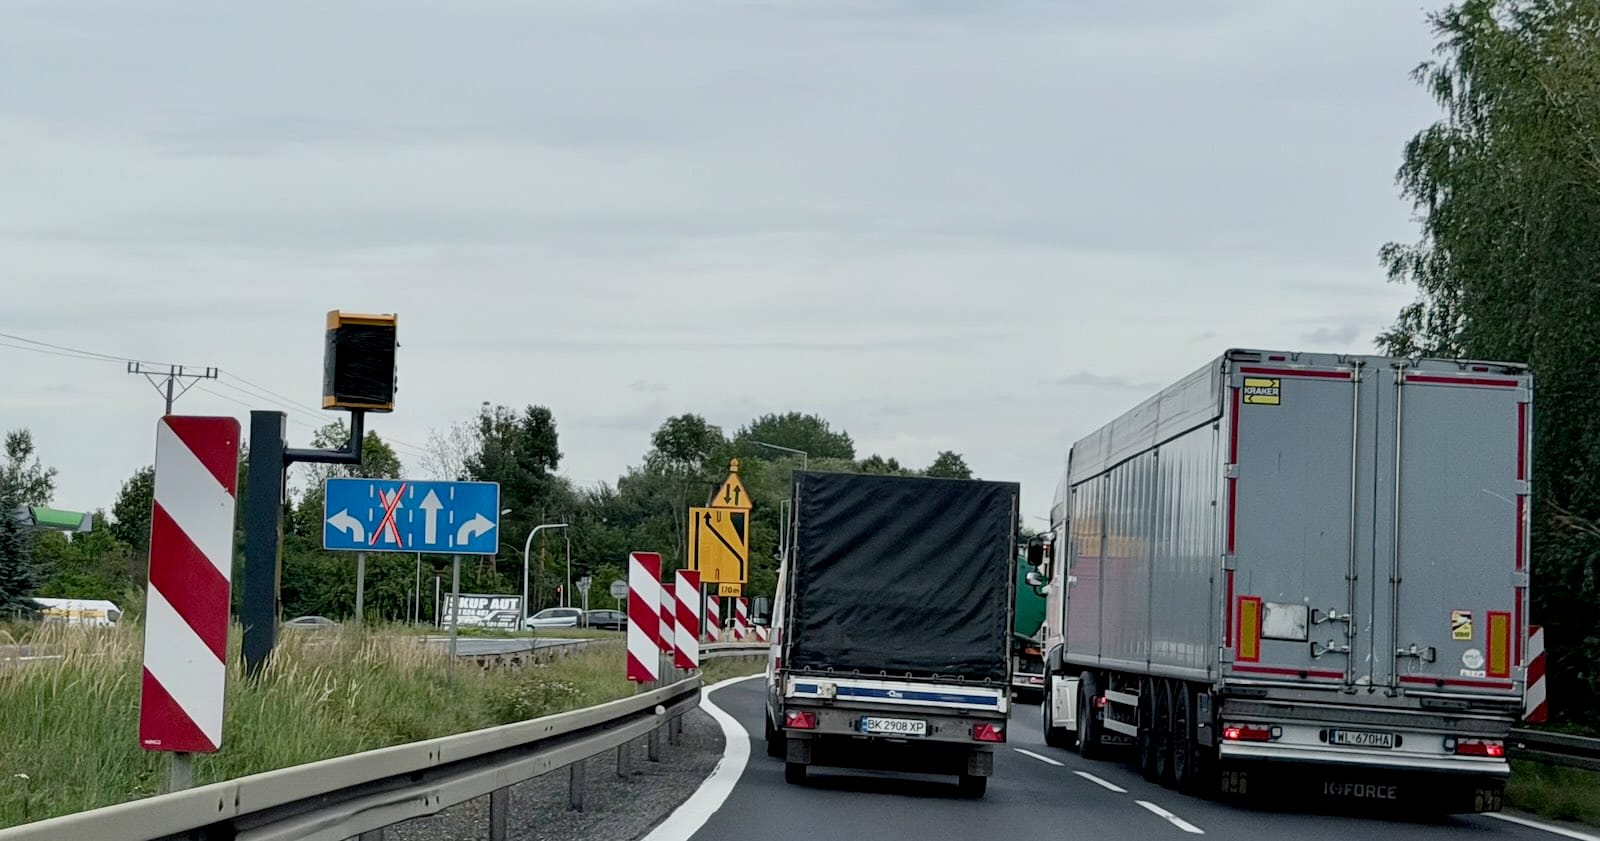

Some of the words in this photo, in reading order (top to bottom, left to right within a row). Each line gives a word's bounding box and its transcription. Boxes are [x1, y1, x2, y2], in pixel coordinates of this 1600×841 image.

[1244, 387, 1279, 396] KRAKER
[490, 597, 518, 609] AUT
[868, 719, 882, 730] BK
[884, 720, 908, 731] 2908
[910, 722, 924, 732] XP
[1337, 731, 1351, 743] WL
[1355, 733, 1390, 745] 670HA
